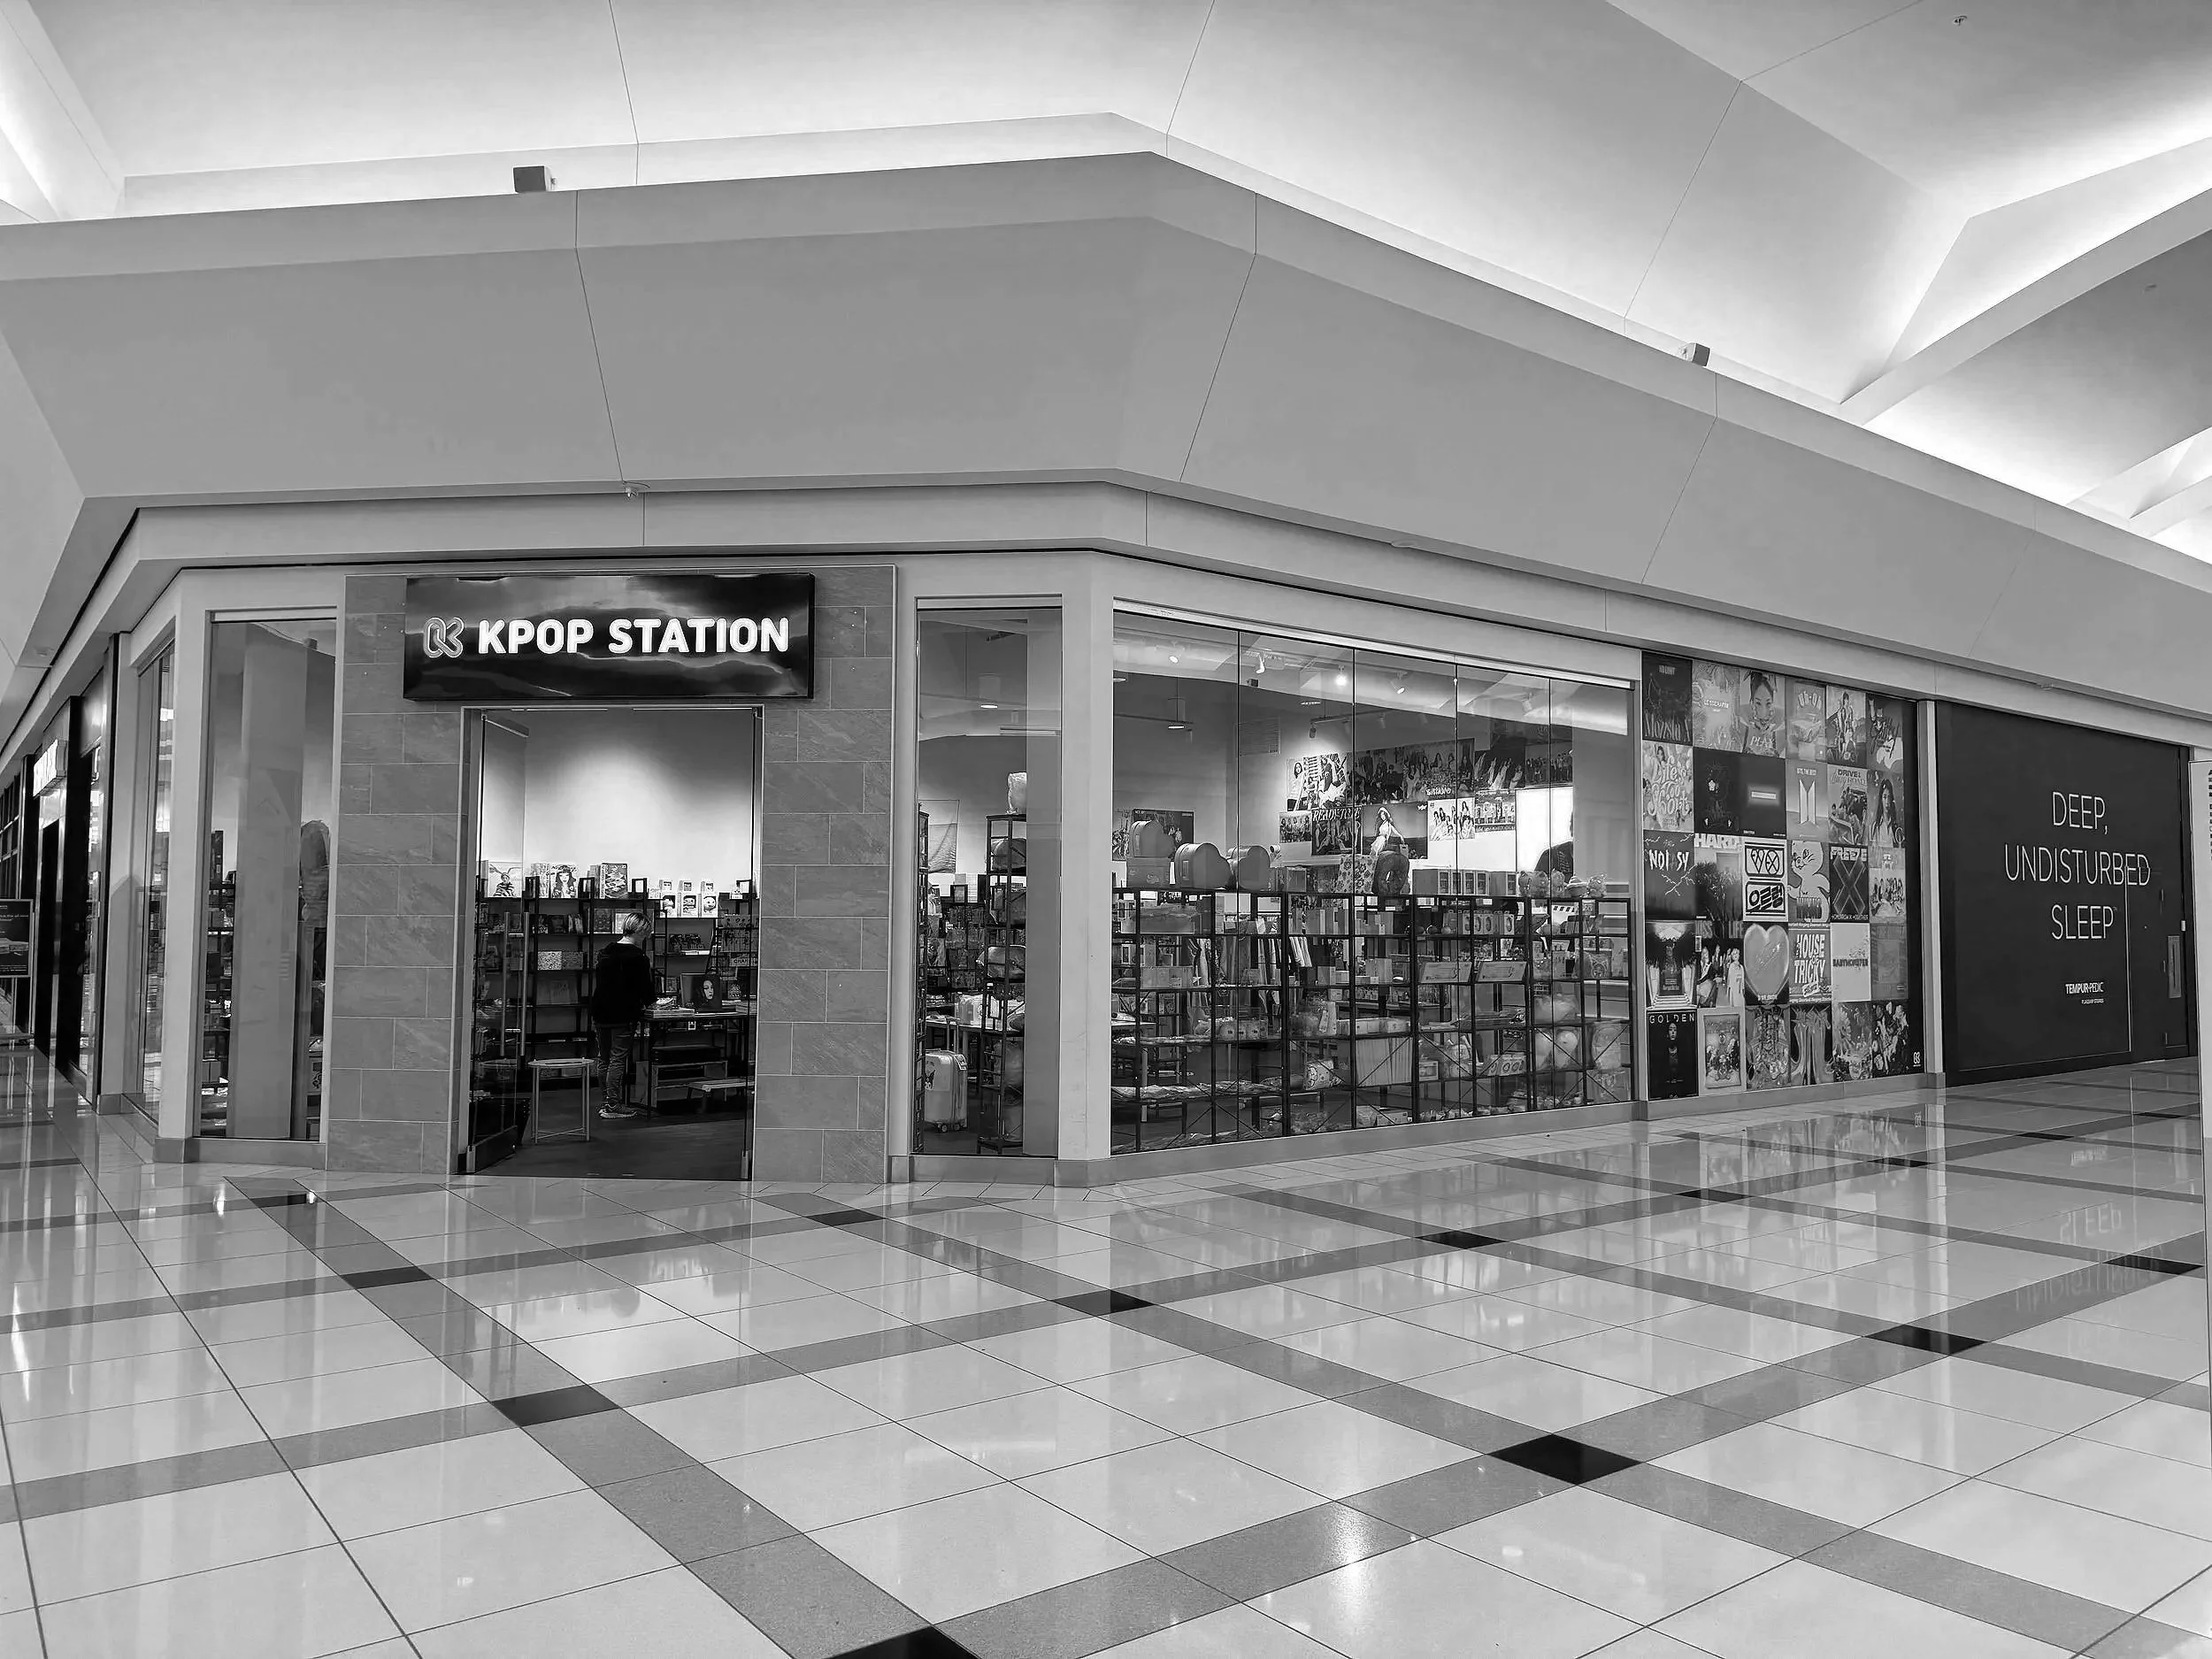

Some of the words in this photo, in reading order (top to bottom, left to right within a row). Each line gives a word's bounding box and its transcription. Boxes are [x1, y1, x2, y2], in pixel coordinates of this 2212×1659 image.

[478, 618, 593, 655] KPOP
[608, 618, 789, 654] STATION
[2052, 791, 2108, 835] DEEP,
[1831, 846, 1868, 862] FREEZE
[2005, 843, 2151, 886] UNDISTURBED
[1794, 933, 1825, 958] HOUSE
[1794, 960, 1826, 984] TRICKY
[1649, 1013, 1694, 1024] GOLDEN
